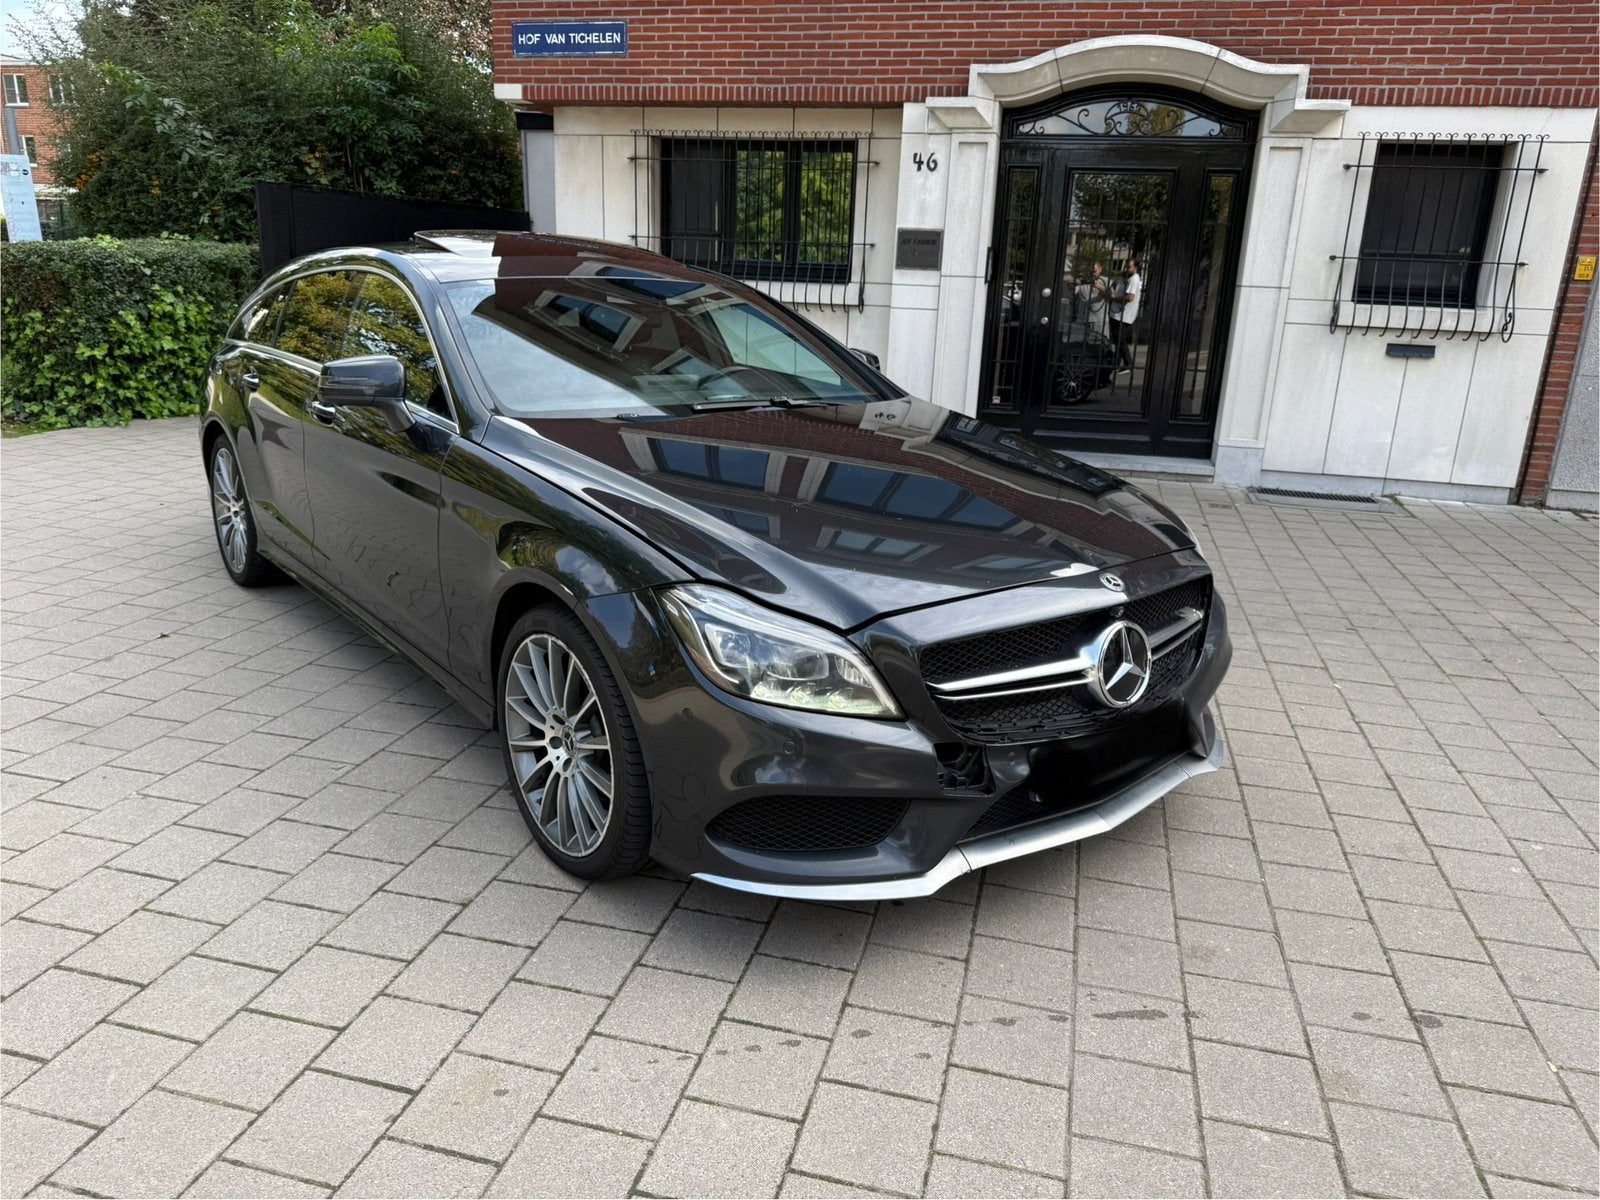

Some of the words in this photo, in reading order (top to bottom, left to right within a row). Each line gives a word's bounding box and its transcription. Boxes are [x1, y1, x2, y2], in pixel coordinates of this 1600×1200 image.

[518, 34, 541, 45] HOF
[545, 33, 566, 44] VAN
[568, 32, 621, 44] TICHELEN
[913, 152, 938, 172] 46
